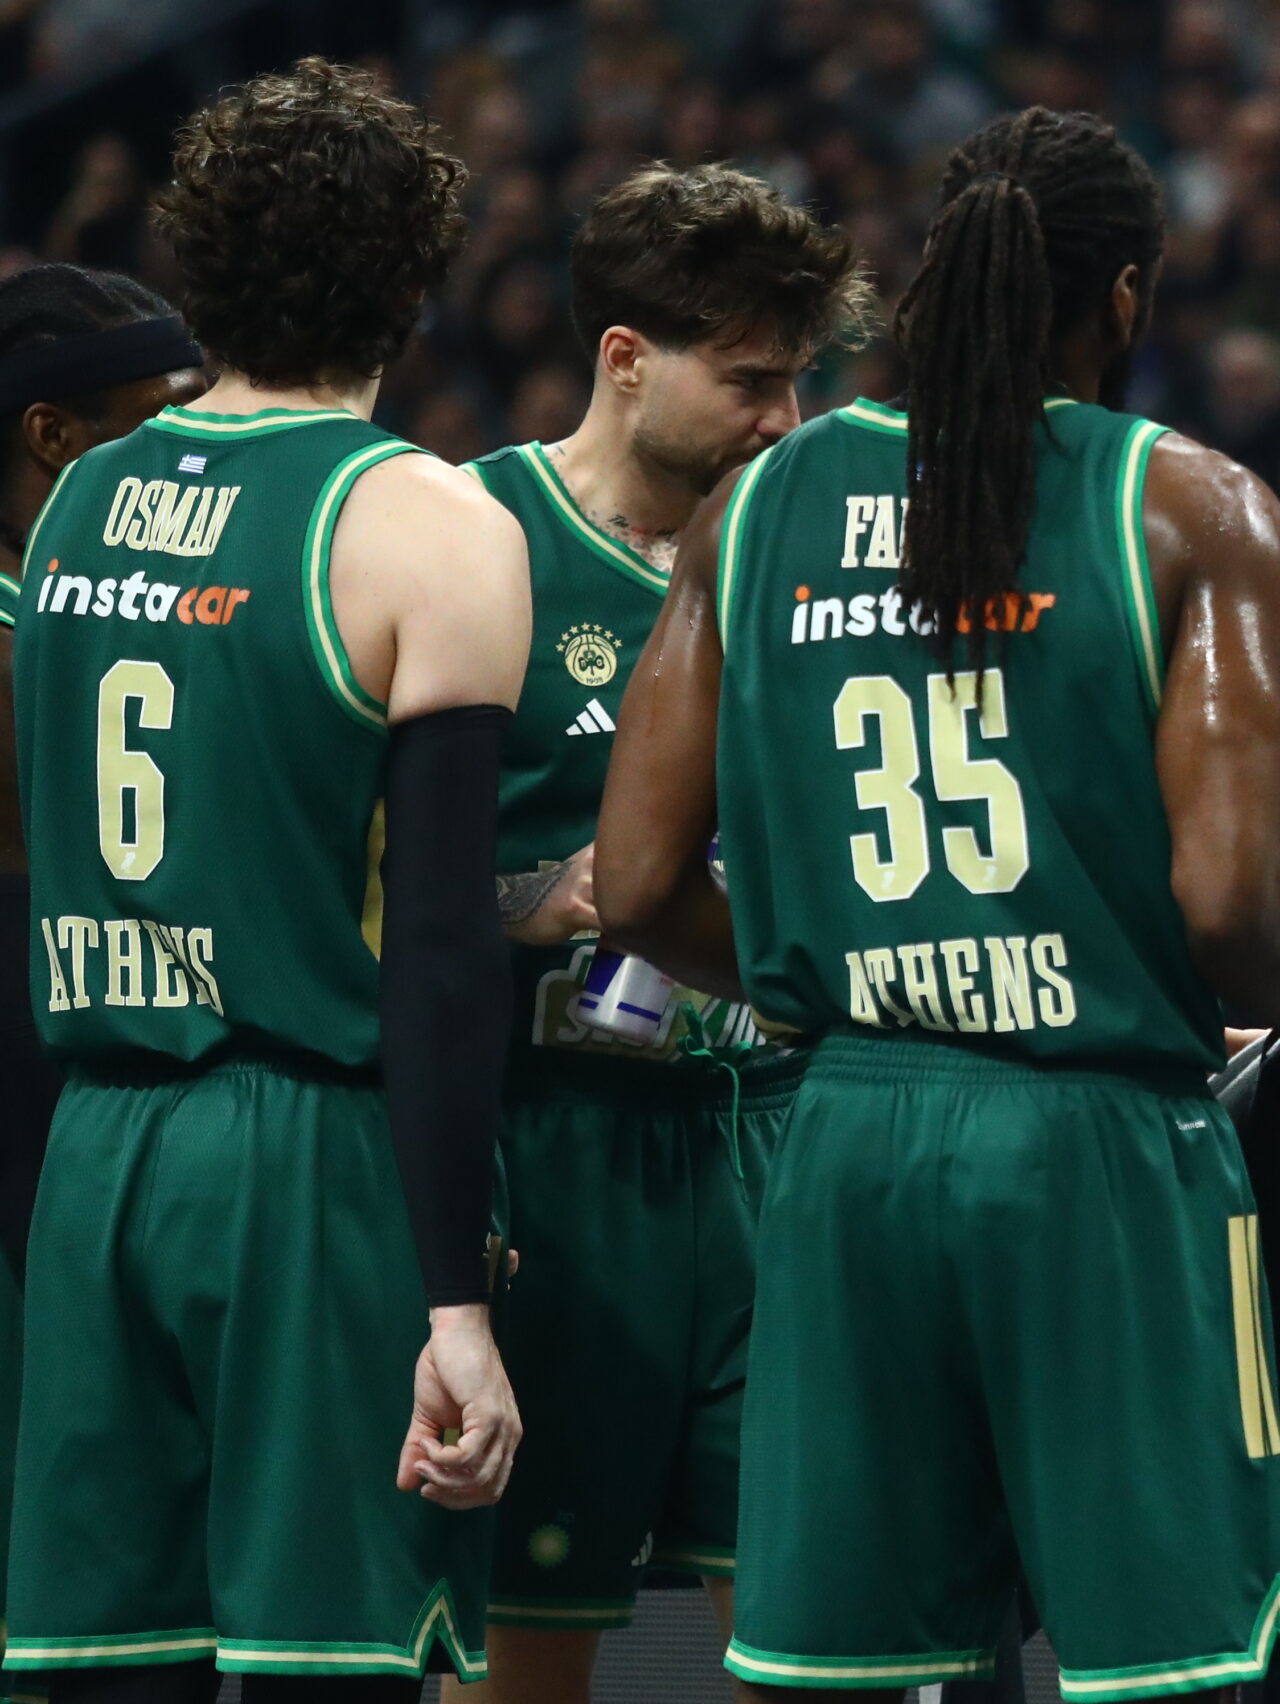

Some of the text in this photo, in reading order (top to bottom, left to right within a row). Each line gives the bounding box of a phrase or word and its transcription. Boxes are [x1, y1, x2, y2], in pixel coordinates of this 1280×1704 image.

[102, 476, 241, 557] OSMAN
[841, 495, 909, 569] FA
[37, 558, 251, 625] instacar
[97, 659, 175, 881] 6
[833, 669, 1029, 902] 35
[845, 934, 1077, 1033] ATHENS
